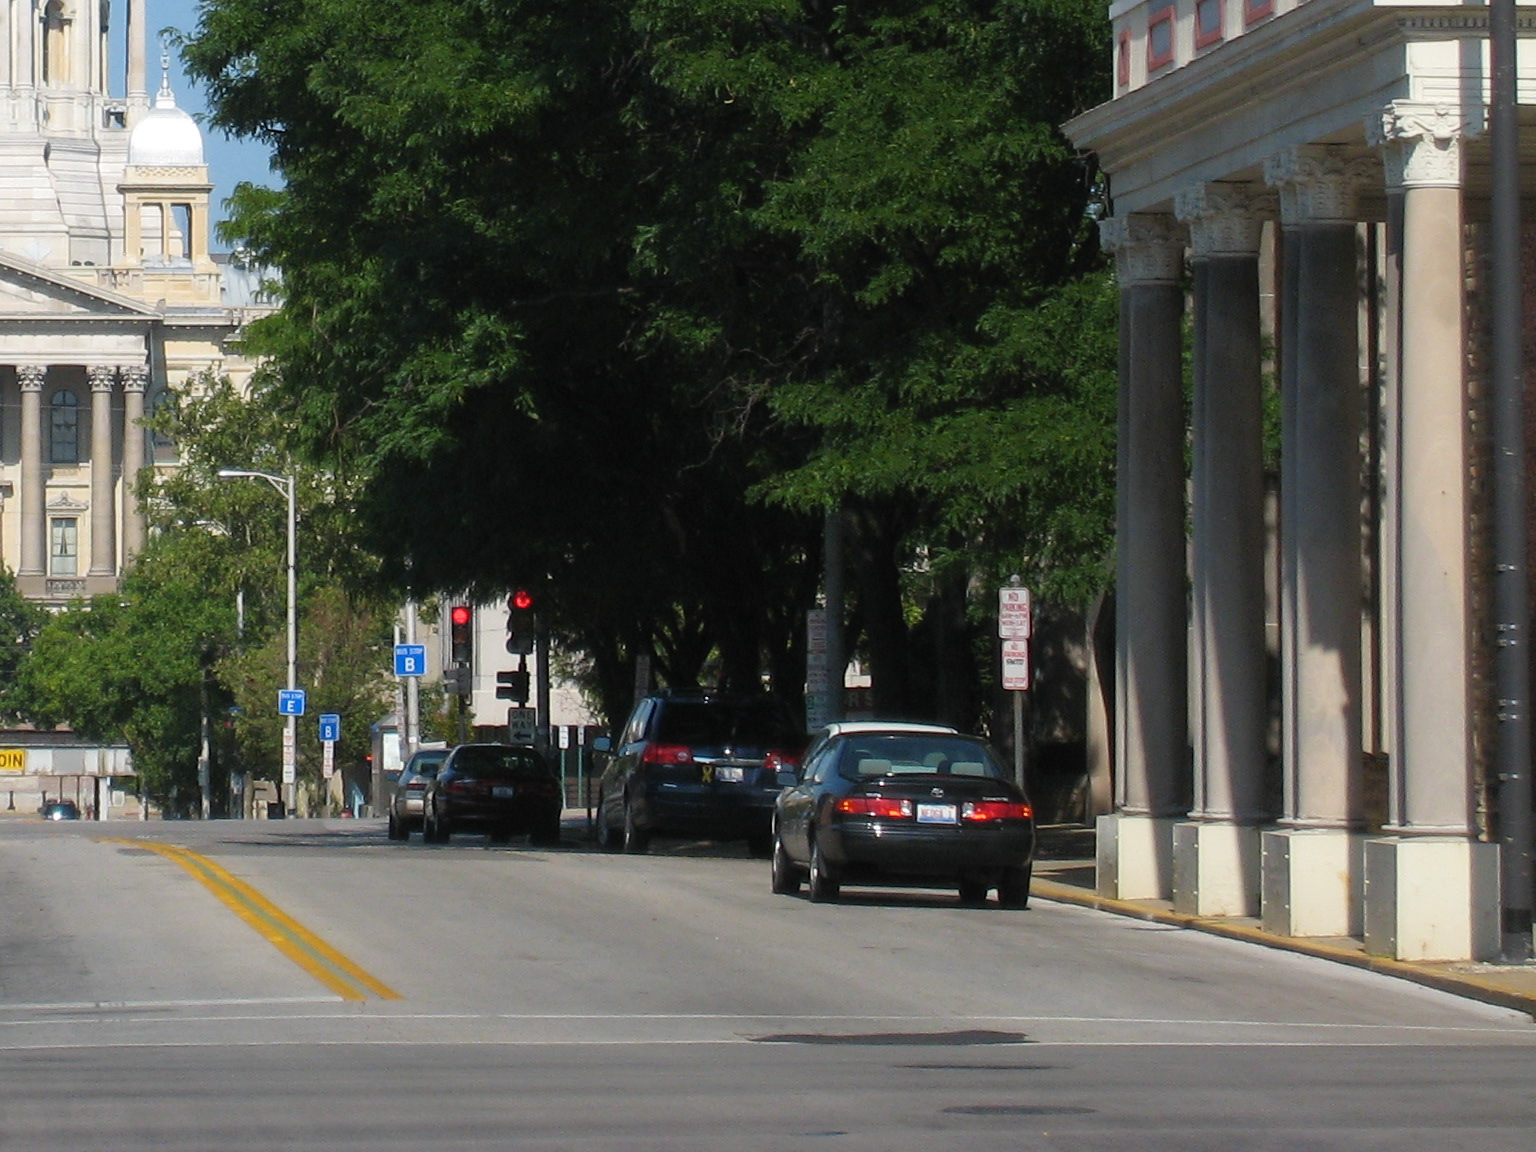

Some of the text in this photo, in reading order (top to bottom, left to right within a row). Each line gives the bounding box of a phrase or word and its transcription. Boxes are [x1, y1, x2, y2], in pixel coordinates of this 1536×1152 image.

[405, 657, 415, 672] B
[287, 700, 295, 712] E
[512, 711, 533, 719] ONE
[511, 721, 532, 729] WAY
[325, 726, 332, 738] B
